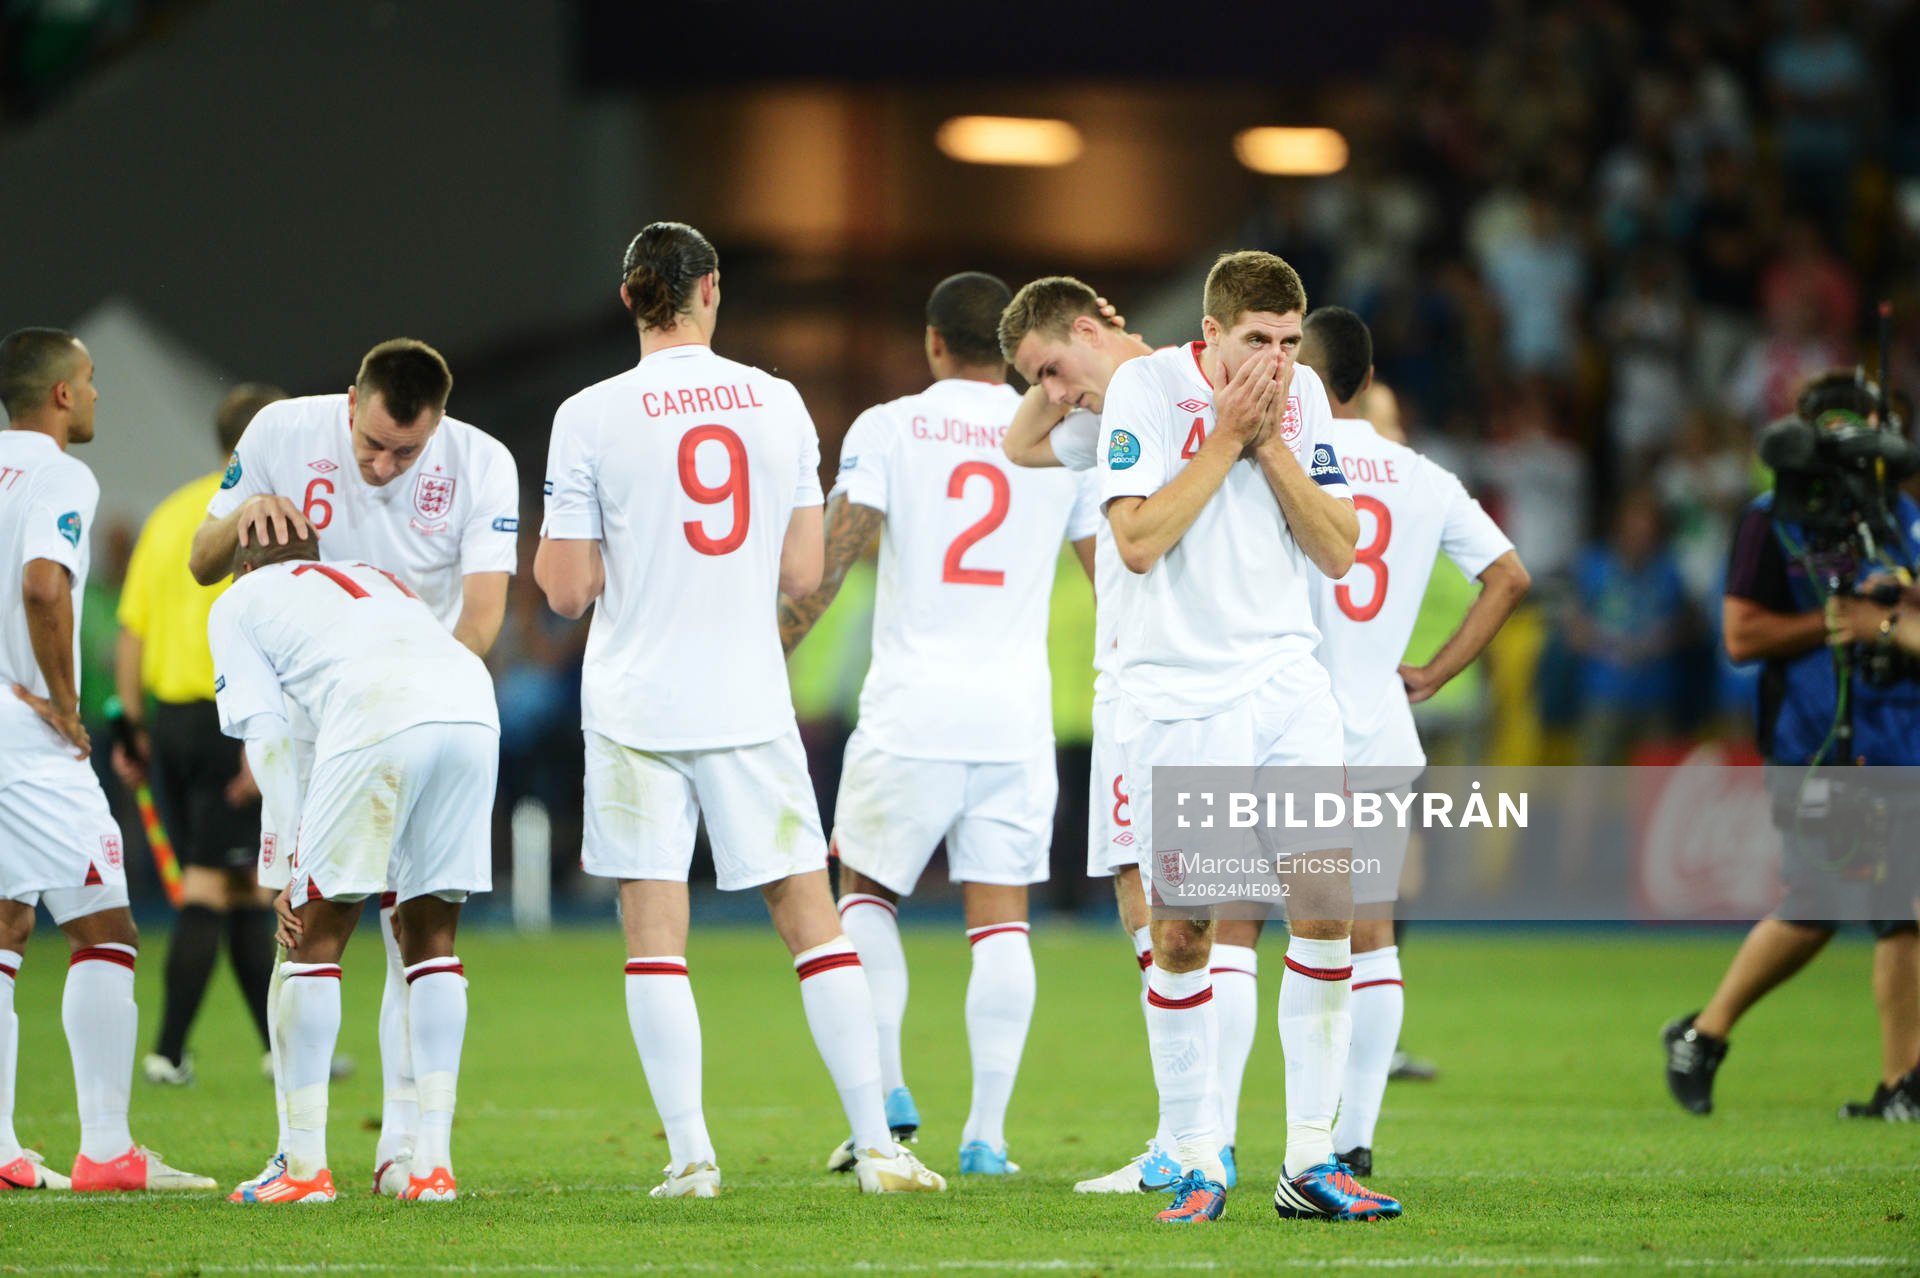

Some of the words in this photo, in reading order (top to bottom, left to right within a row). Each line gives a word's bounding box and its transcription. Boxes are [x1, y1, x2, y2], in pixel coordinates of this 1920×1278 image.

[642, 383, 763, 417] CARROLL
[1181, 417, 1206, 459] 4
[677, 424, 751, 557] 9
[1342, 456, 1399, 483] COLE
[303, 477, 334, 530] 6
[942, 460, 1011, 587] 2
[1334, 494, 1392, 622] 3
